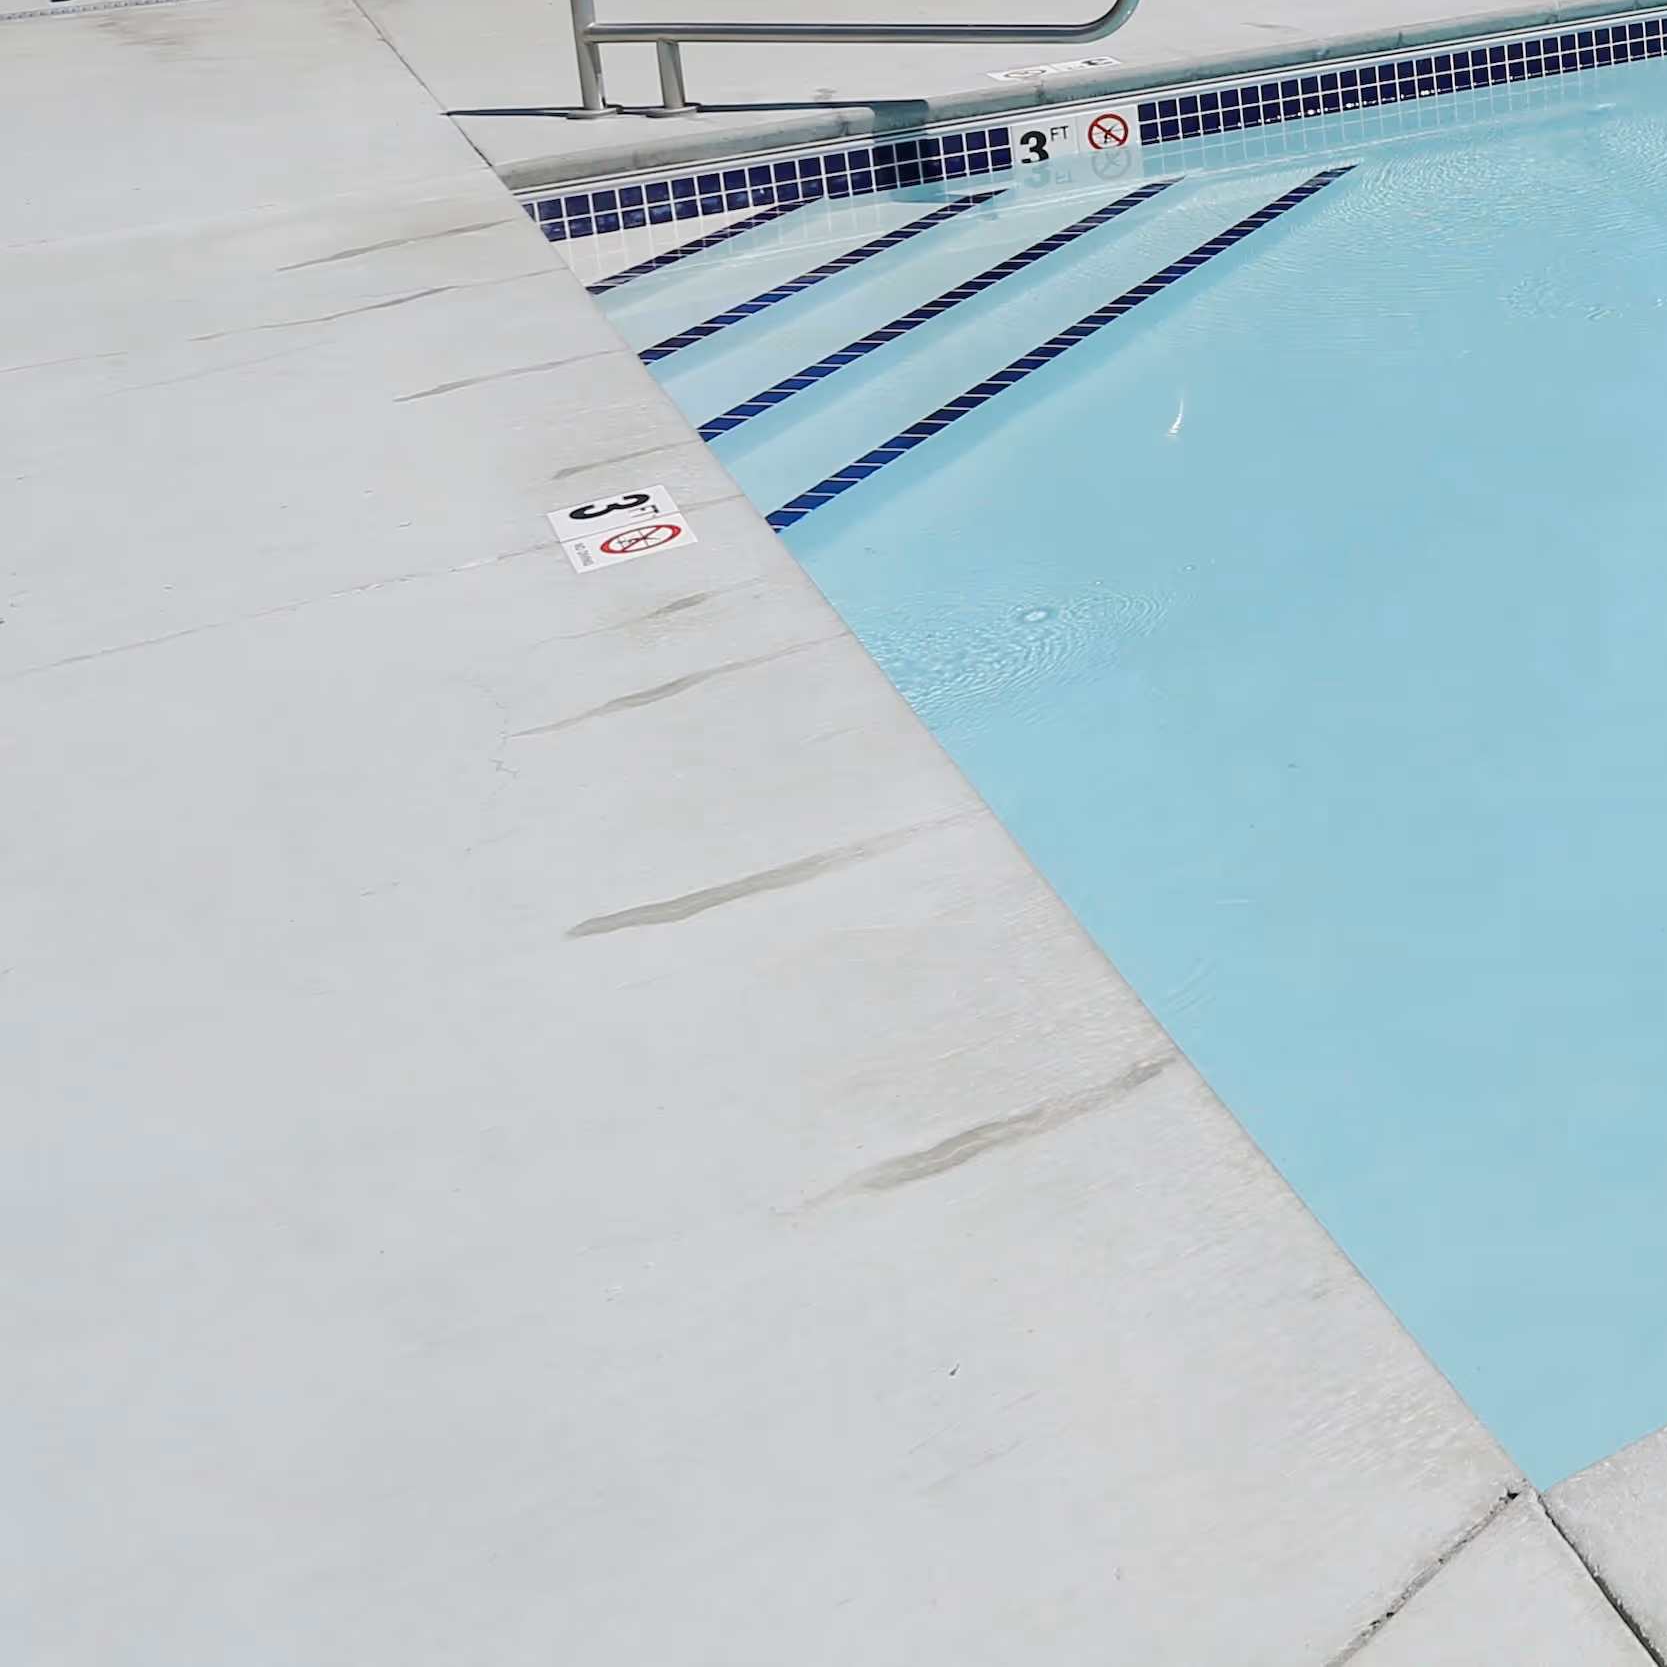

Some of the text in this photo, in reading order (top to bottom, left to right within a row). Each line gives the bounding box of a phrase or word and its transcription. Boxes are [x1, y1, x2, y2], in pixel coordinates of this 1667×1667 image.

[1020, 125, 1069, 164] 3 FT
[569, 493, 650, 520] 3
